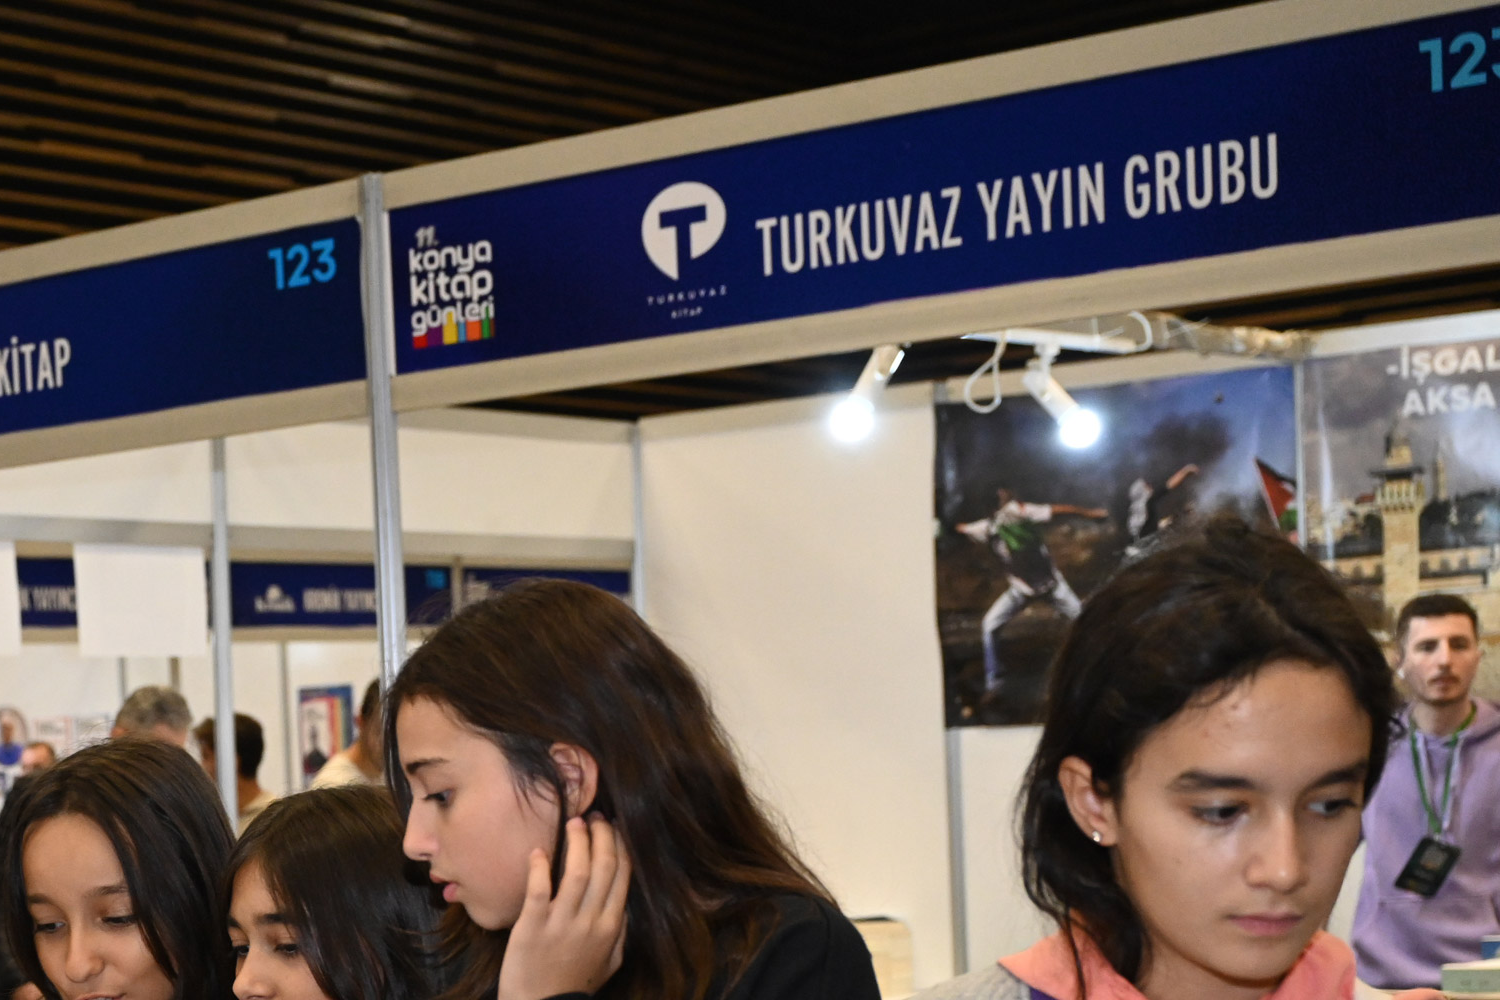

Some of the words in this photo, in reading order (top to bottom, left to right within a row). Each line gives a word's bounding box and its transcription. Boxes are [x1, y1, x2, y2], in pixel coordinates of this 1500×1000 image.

[1418, 27, 1500, 93] 12
[756, 186, 962, 278] TURKUVAZ
[977, 161, 1104, 242] YAYIN
[1124, 133, 1278, 220] GRUBU
[267, 237, 337, 290] 123
[408, 240, 493, 273] konya
[410, 269, 494, 307] kitap
[411, 296, 495, 336] günleri
